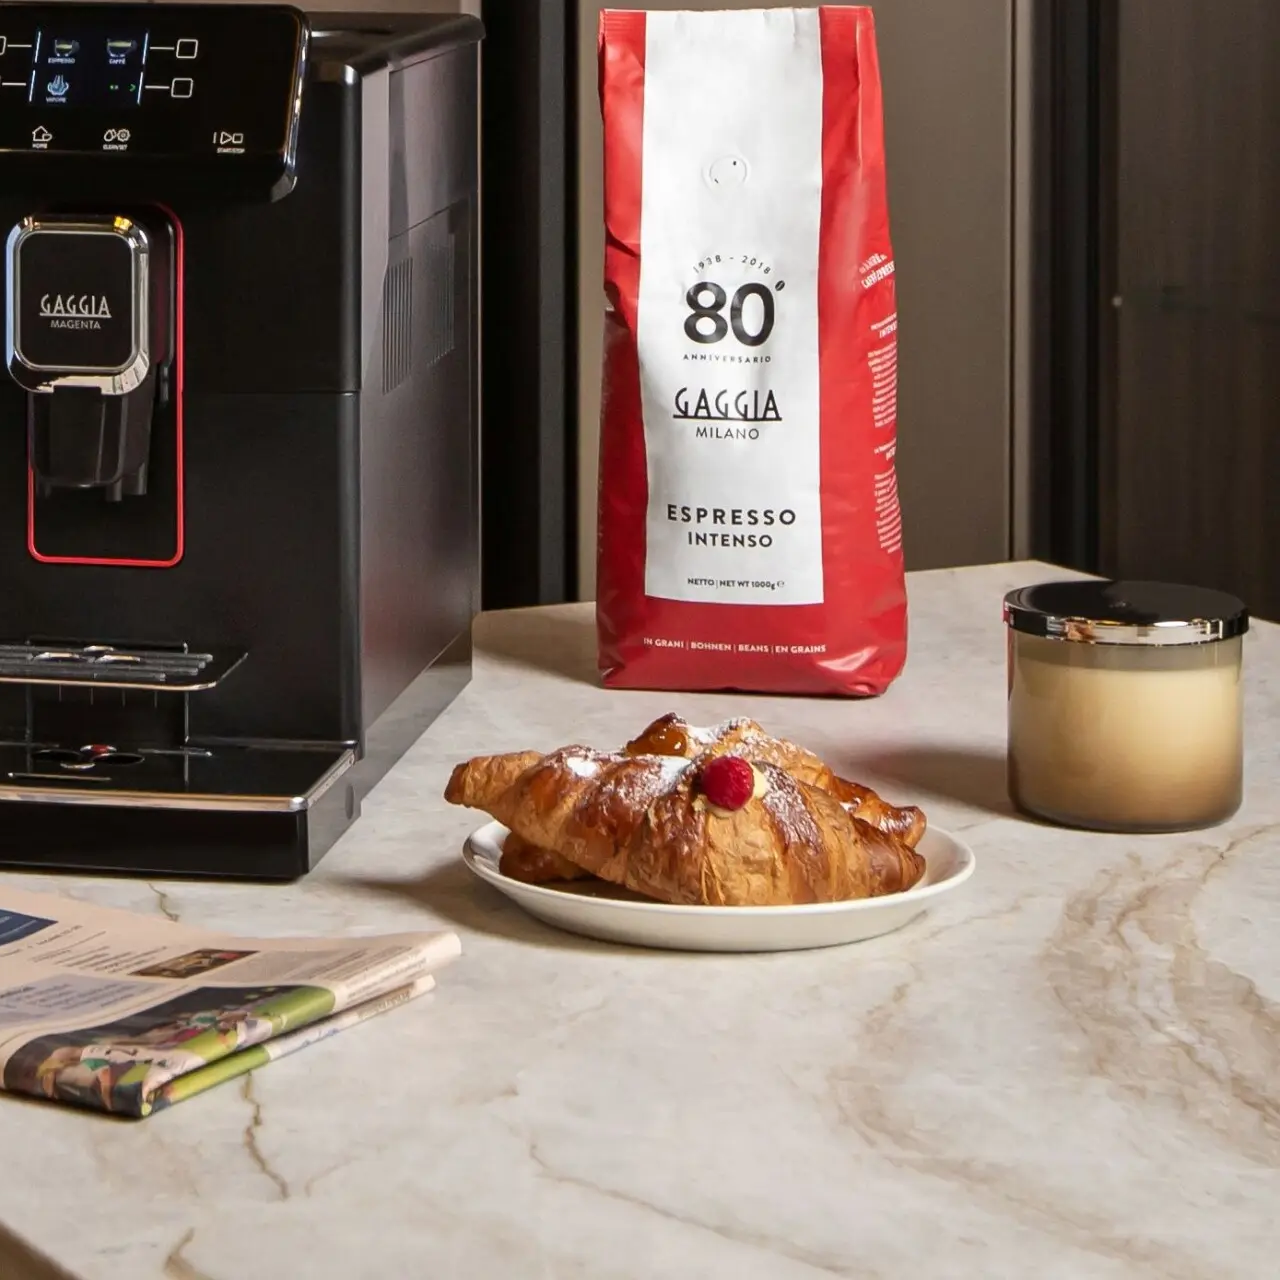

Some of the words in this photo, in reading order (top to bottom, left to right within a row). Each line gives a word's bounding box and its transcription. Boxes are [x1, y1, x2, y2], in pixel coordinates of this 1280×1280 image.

[741, 255, 771, 274] 2018
[39, 293, 112, 318] GAGGIA
[50, 319, 101, 330] MAGENTA
[683, 353, 772, 364] ANNIVERSARIO
[672, 387, 783, 422] GAGGIA
[695, 426, 760, 440] MILANO
[667, 503, 797, 526] ESPRESSO
[687, 531, 773, 548] INTENSO
[687, 577, 715, 587] NETTO
[719, 579, 735, 588] NET
[737, 580, 750, 588] WT
[643, 637, 653, 646] IN
[654, 638, 684, 649] GRANI
[690, 641, 732, 652] BOHNEN
[738, 644, 769, 653] BEANS
[775, 645, 789, 653] EN
[790, 644, 826, 654] GRAINS
